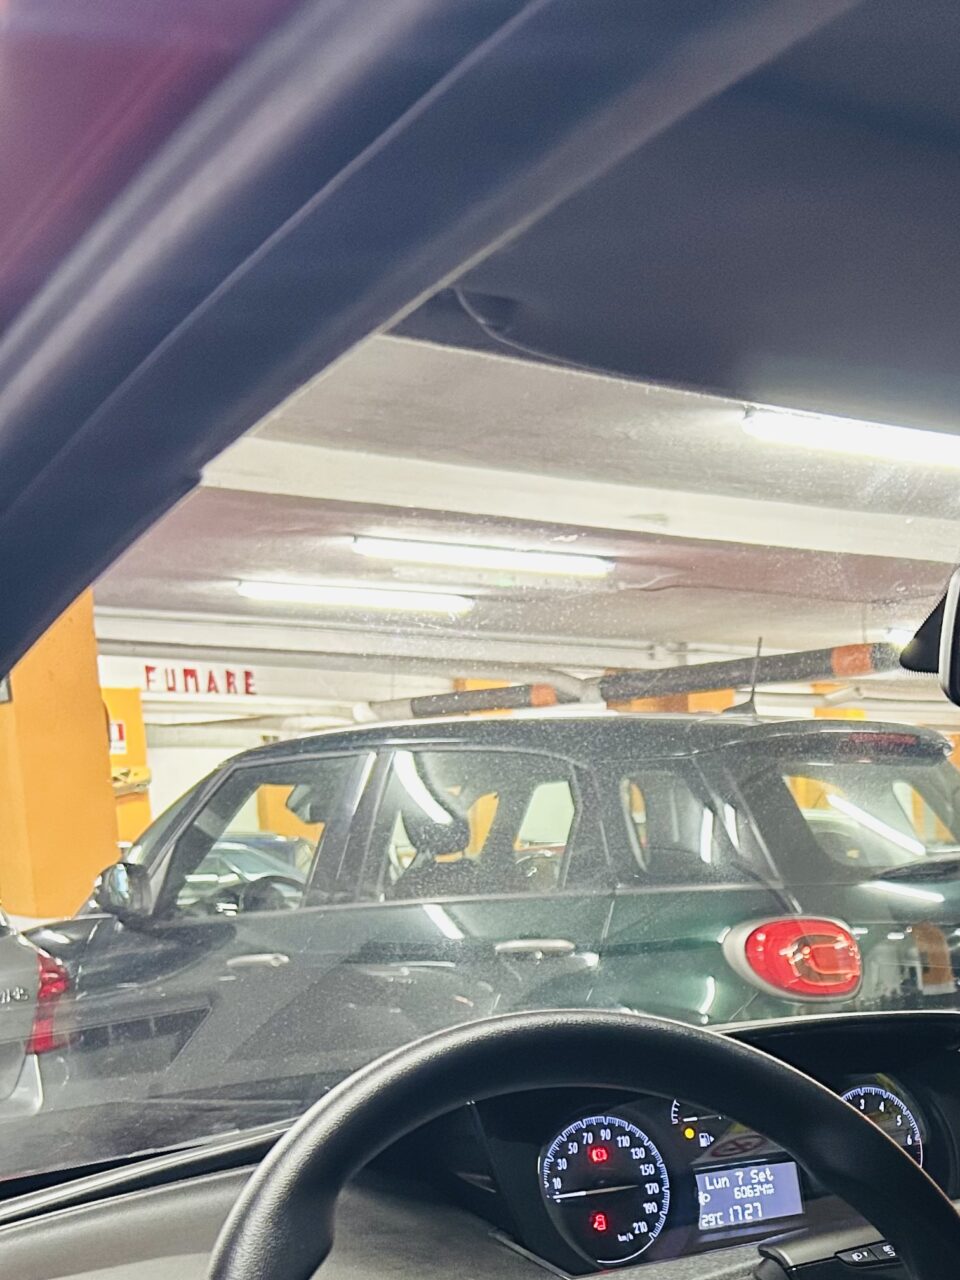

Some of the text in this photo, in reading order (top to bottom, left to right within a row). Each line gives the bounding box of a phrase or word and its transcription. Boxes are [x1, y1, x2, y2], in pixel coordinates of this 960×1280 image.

[145, 665, 257, 695] FUMARE
[860, 1098, 865, 1110] 3
[878, 1101, 885, 1112] 4
[896, 1114, 902, 1126] 5
[582, 1132, 593, 1144] 70
[600, 1129, 611, 1141] 90
[906, 1134, 912, 1145] 6
[568, 1142, 578, 1154] 50
[616, 1136, 630, 1148] 110
[631, 1147, 645, 1159] 130
[557, 1158, 567, 1171] 30
[640, 1164, 655, 1176] 150
[552, 1177, 562, 1190] 10
[705, 1167, 774, 1190] Lun 7 Set
[645, 1182, 659, 1195] 170
[734, 1184, 765, 1199] 60634
[643, 1202, 658, 1214] 190
[632, 1221, 648, 1234] 210
[617, 1232, 634, 1242] km/h
